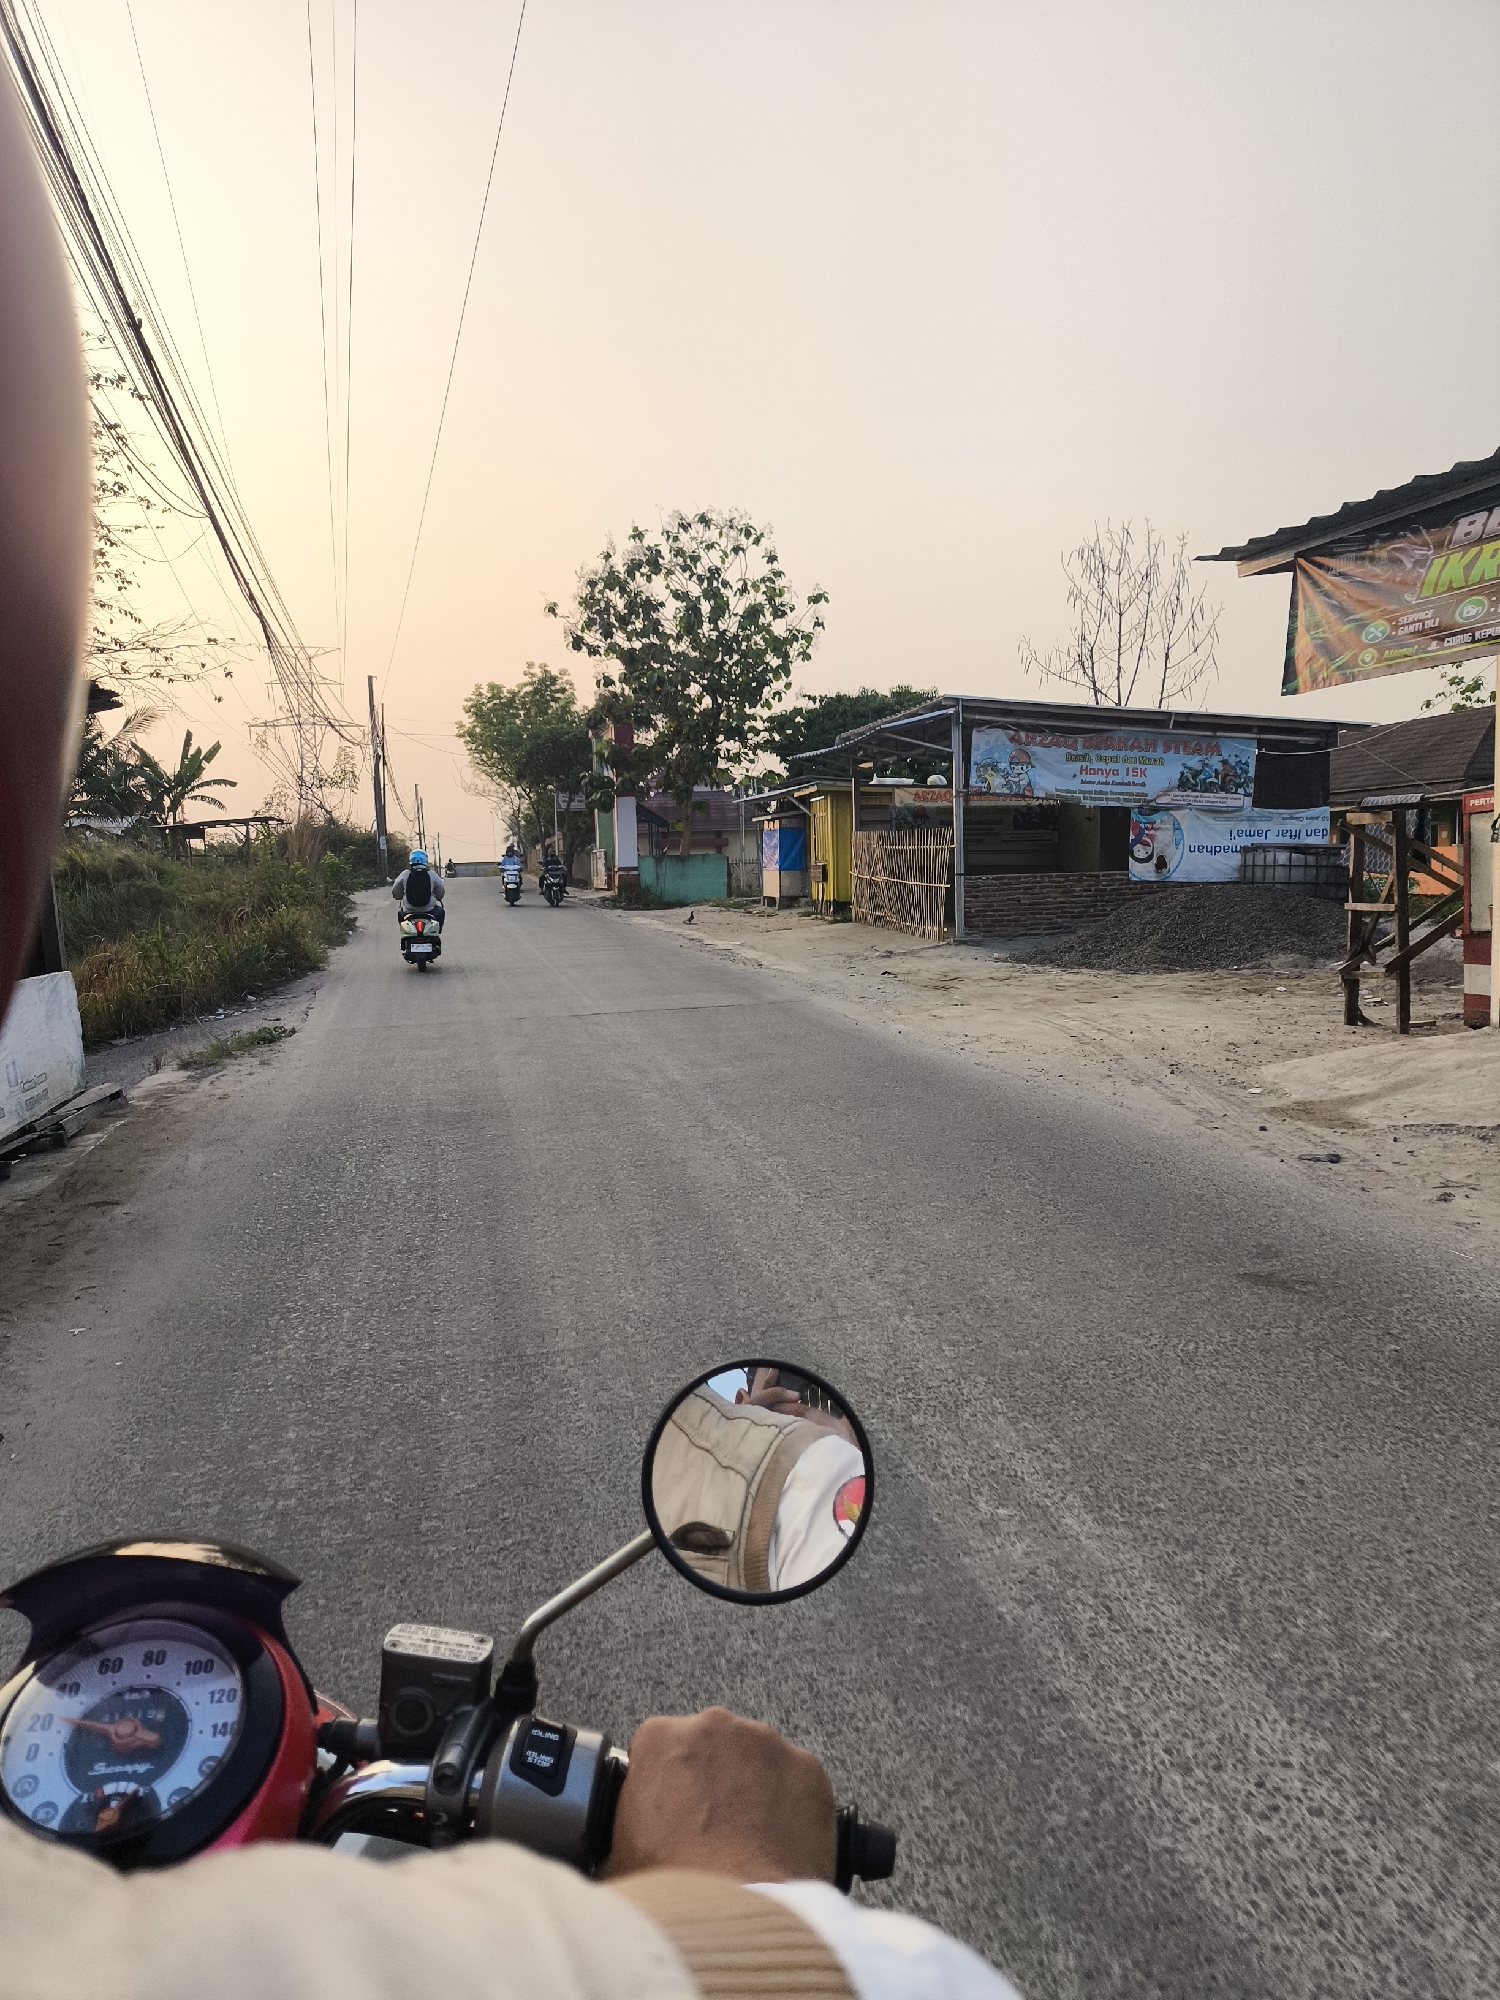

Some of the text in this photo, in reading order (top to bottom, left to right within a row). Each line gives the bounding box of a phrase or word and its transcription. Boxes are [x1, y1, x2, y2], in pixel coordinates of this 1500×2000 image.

[1398, 609, 1434, 625] SERVICE
[1398, 618, 1439, 635] GANTI OLI
[1443, 633, 1472, 646] CURUG
[1009, 731, 1222, 756] ARZAQ BERKAH STEAM
[1122, 755, 1137, 764] dan
[1138, 756, 1164, 766] Murah
[1080, 765, 1147, 779] Hanya 15K
[1229, 828, 1329, 840] dan Iftar Jama'i
[98, 1656, 124, 1675] 60
[141, 1650, 167, 1667] 80
[184, 1658, 215, 1676] 100
[57, 1681, 81, 1698] 40
[208, 1687, 238, 1705] 120
[27, 1713, 54, 1733] 20
[531, 1729, 559, 1741] IDLING
[25, 1743, 40, 1762] 0
[526, 1750, 554, 1763] IDLING
[526, 1757, 551, 1768] STOP
